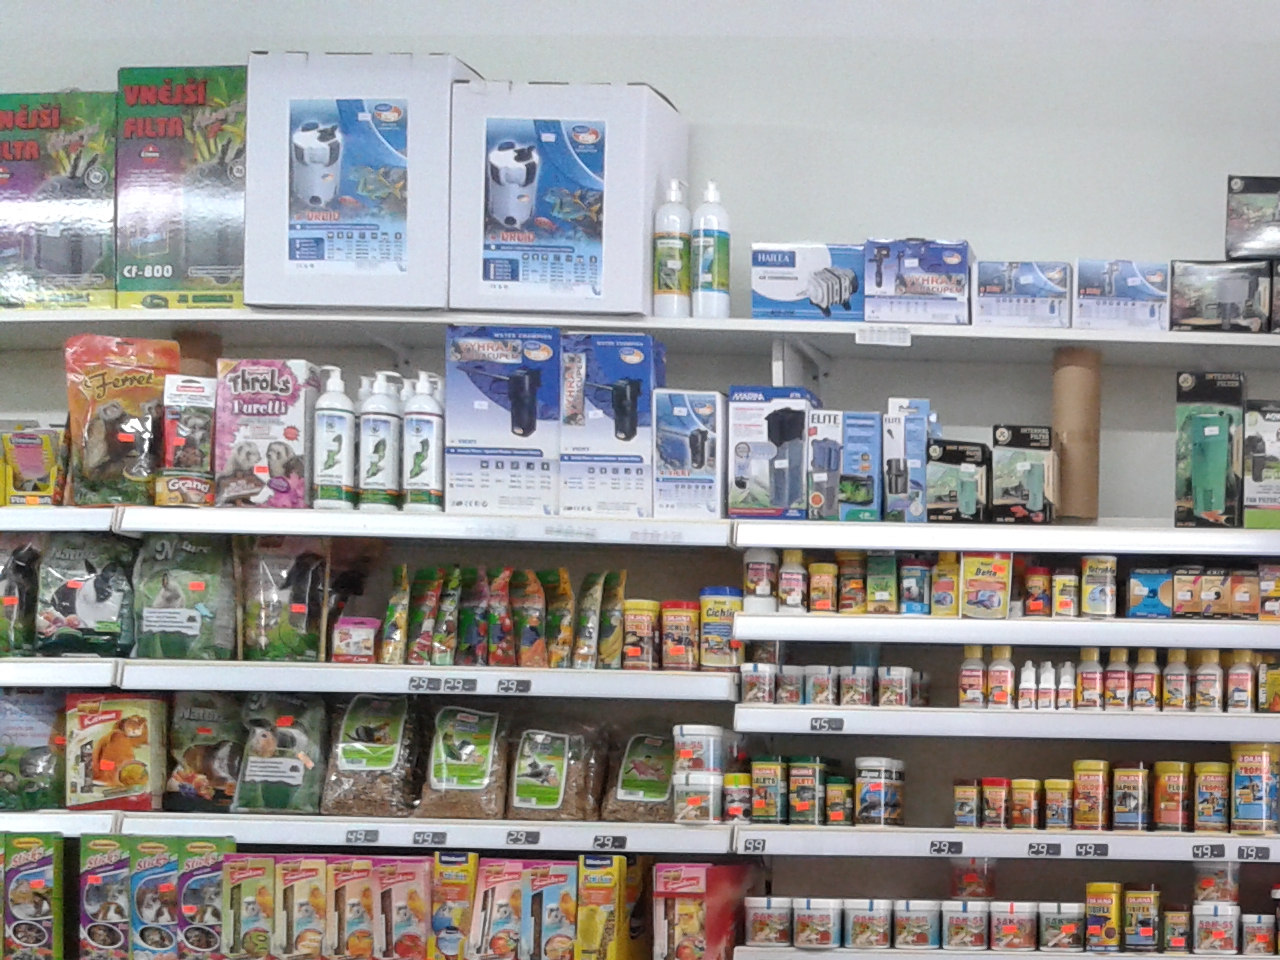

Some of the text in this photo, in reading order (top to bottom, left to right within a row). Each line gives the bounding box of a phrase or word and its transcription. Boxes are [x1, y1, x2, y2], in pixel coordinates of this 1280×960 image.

[124, 78, 207, 106] VNĚJŠÍ
[123, 264, 173, 279] CF-800
[811, 413, 840, 425] ELITE
